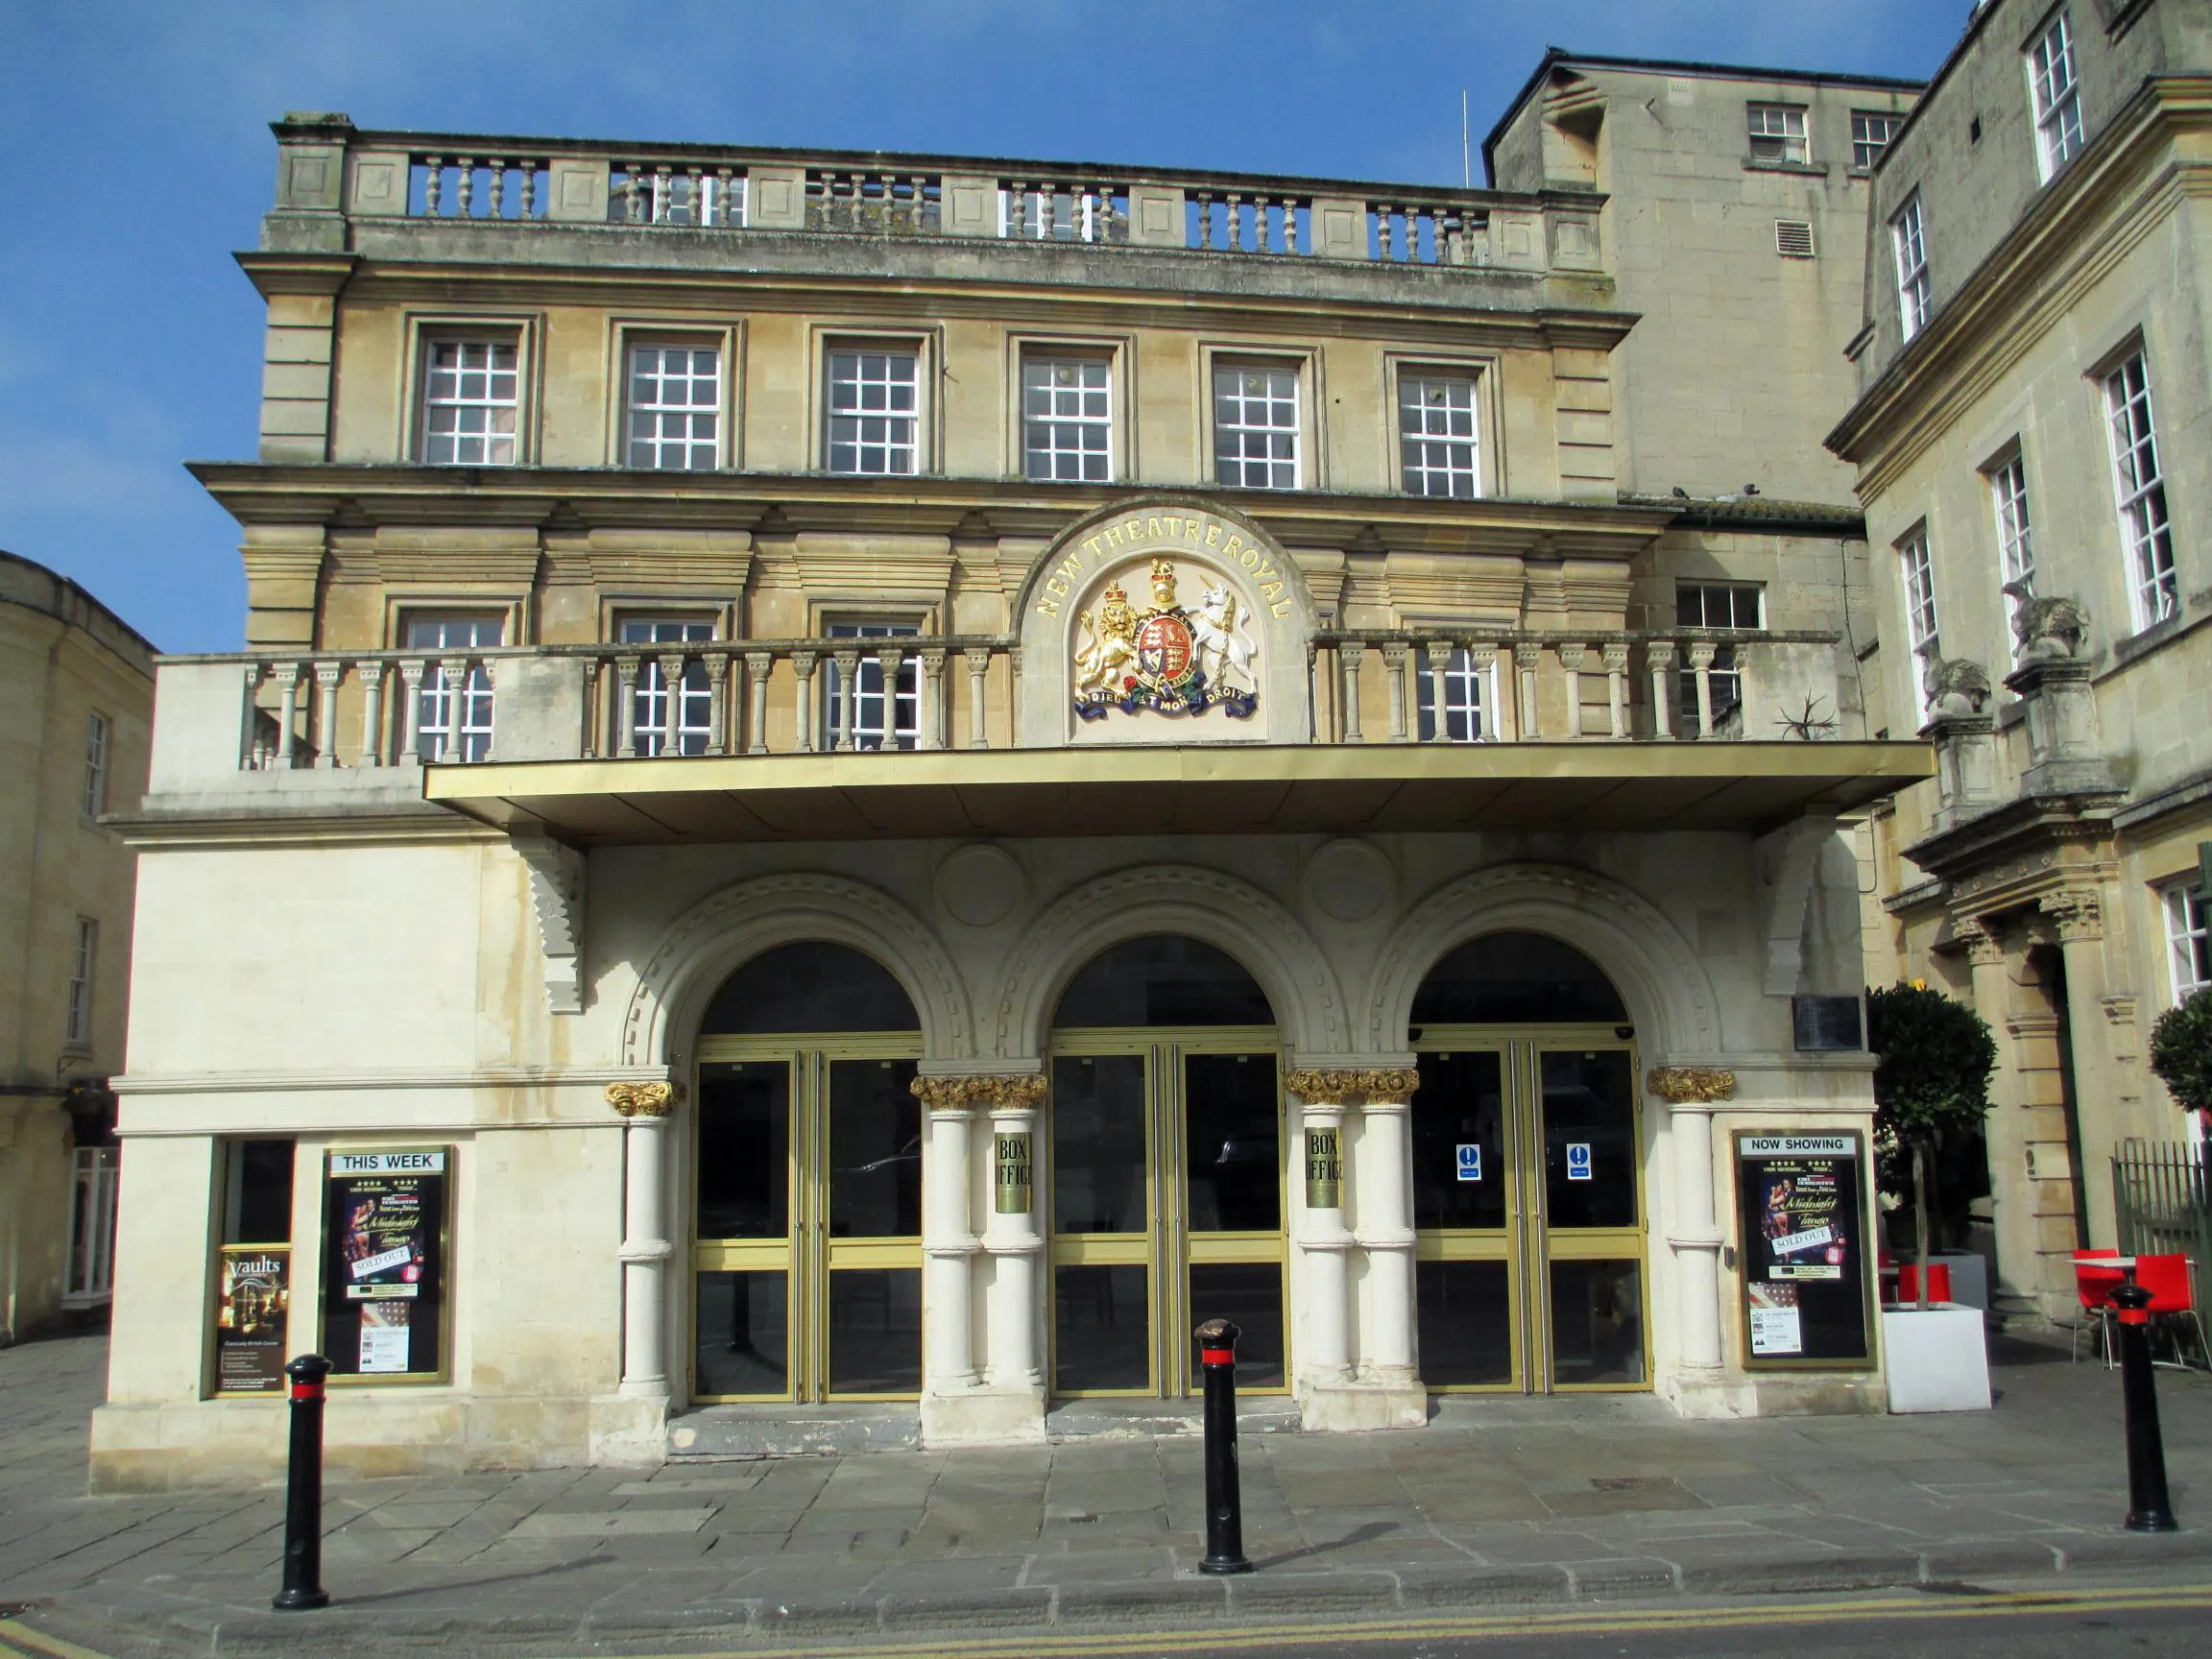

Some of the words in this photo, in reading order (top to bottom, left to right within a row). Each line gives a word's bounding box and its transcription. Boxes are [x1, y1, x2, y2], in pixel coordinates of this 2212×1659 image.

[1036, 552, 1083, 618] NEW
[1081, 516, 1222, 556] THEATRE
[1220, 534, 1292, 619] ROYAL
[1091, 692, 1121, 704] DIEU
[1159, 696, 1189, 710] MON
[1205, 688, 1246, 704] DROIT
[999, 1140, 1026, 1160] BOX
[1310, 1135, 1337, 1155] BOX
[1751, 1139, 1780, 1150] NOW
[1785, 1139, 1844, 1150] SHOWING
[343, 1155, 379, 1169] THIS
[386, 1153, 433, 1168] WEEK
[1306, 1160, 1344, 1181] OFFICE
[1776, 1236, 1803, 1249] SOLD
[1805, 1229, 1826, 1241] OUT
[229, 1255, 281, 1278] vaults
[356, 1258, 382, 1272] SOLD
[384, 1249, 406, 1262] OUT
